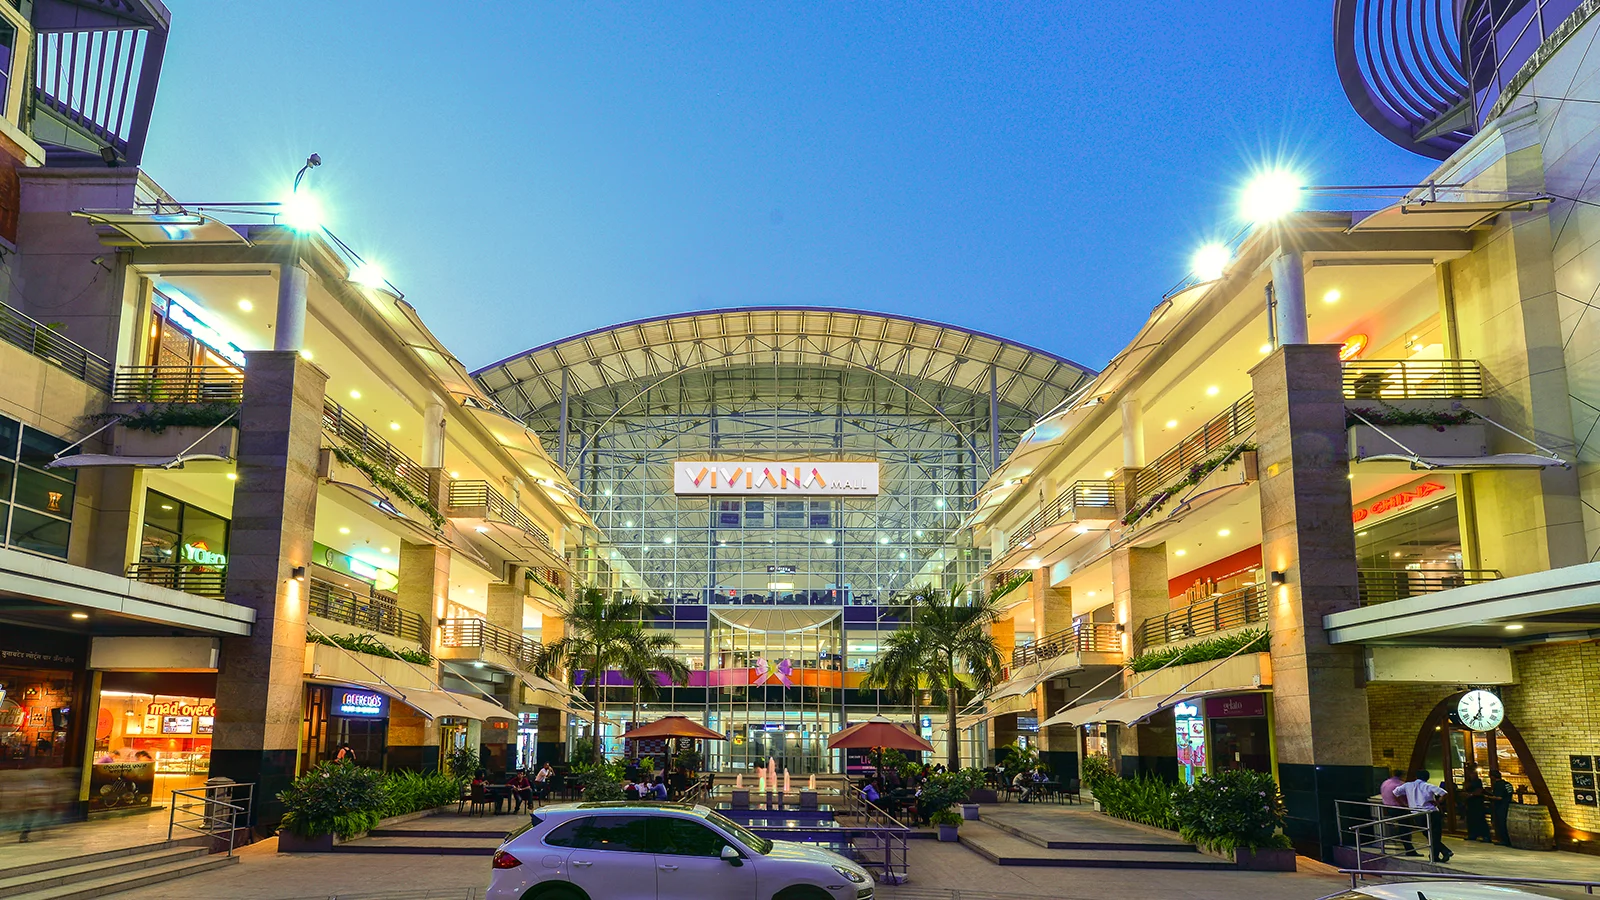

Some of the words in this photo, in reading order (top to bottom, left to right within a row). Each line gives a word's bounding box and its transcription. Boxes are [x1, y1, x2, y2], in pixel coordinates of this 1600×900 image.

[685, 467, 826, 489] VIVIANA
[830, 479, 868, 489] MALL
[1370, 482, 1446, 514] CHINA
[149, 701, 179, 715] mad
[1223, 699, 1243, 714] gelato
